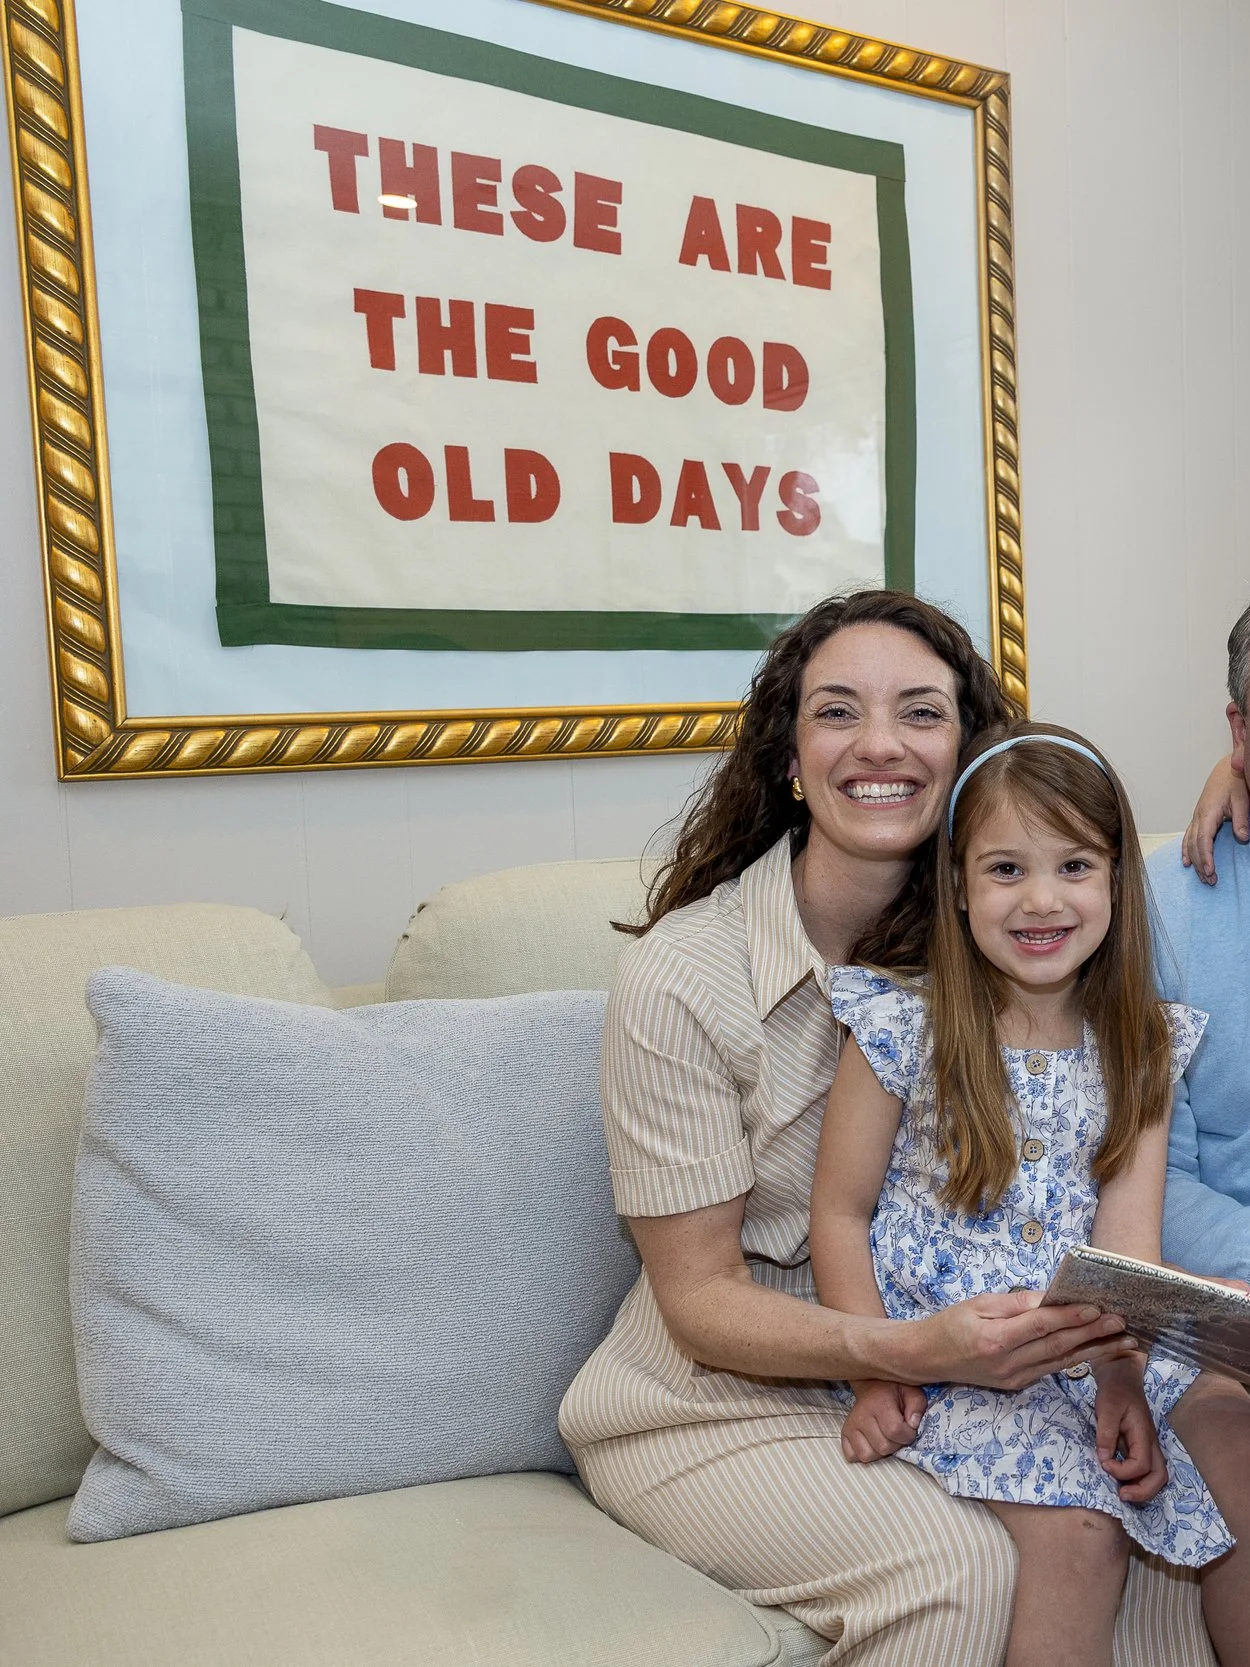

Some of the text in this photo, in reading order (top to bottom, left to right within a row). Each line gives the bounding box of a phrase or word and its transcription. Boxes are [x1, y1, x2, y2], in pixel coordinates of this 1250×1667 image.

[313, 123, 832, 290] THESE ARE
[353, 288, 809, 412] THE GOOD
[371, 442, 821, 536] OLD DAYS
